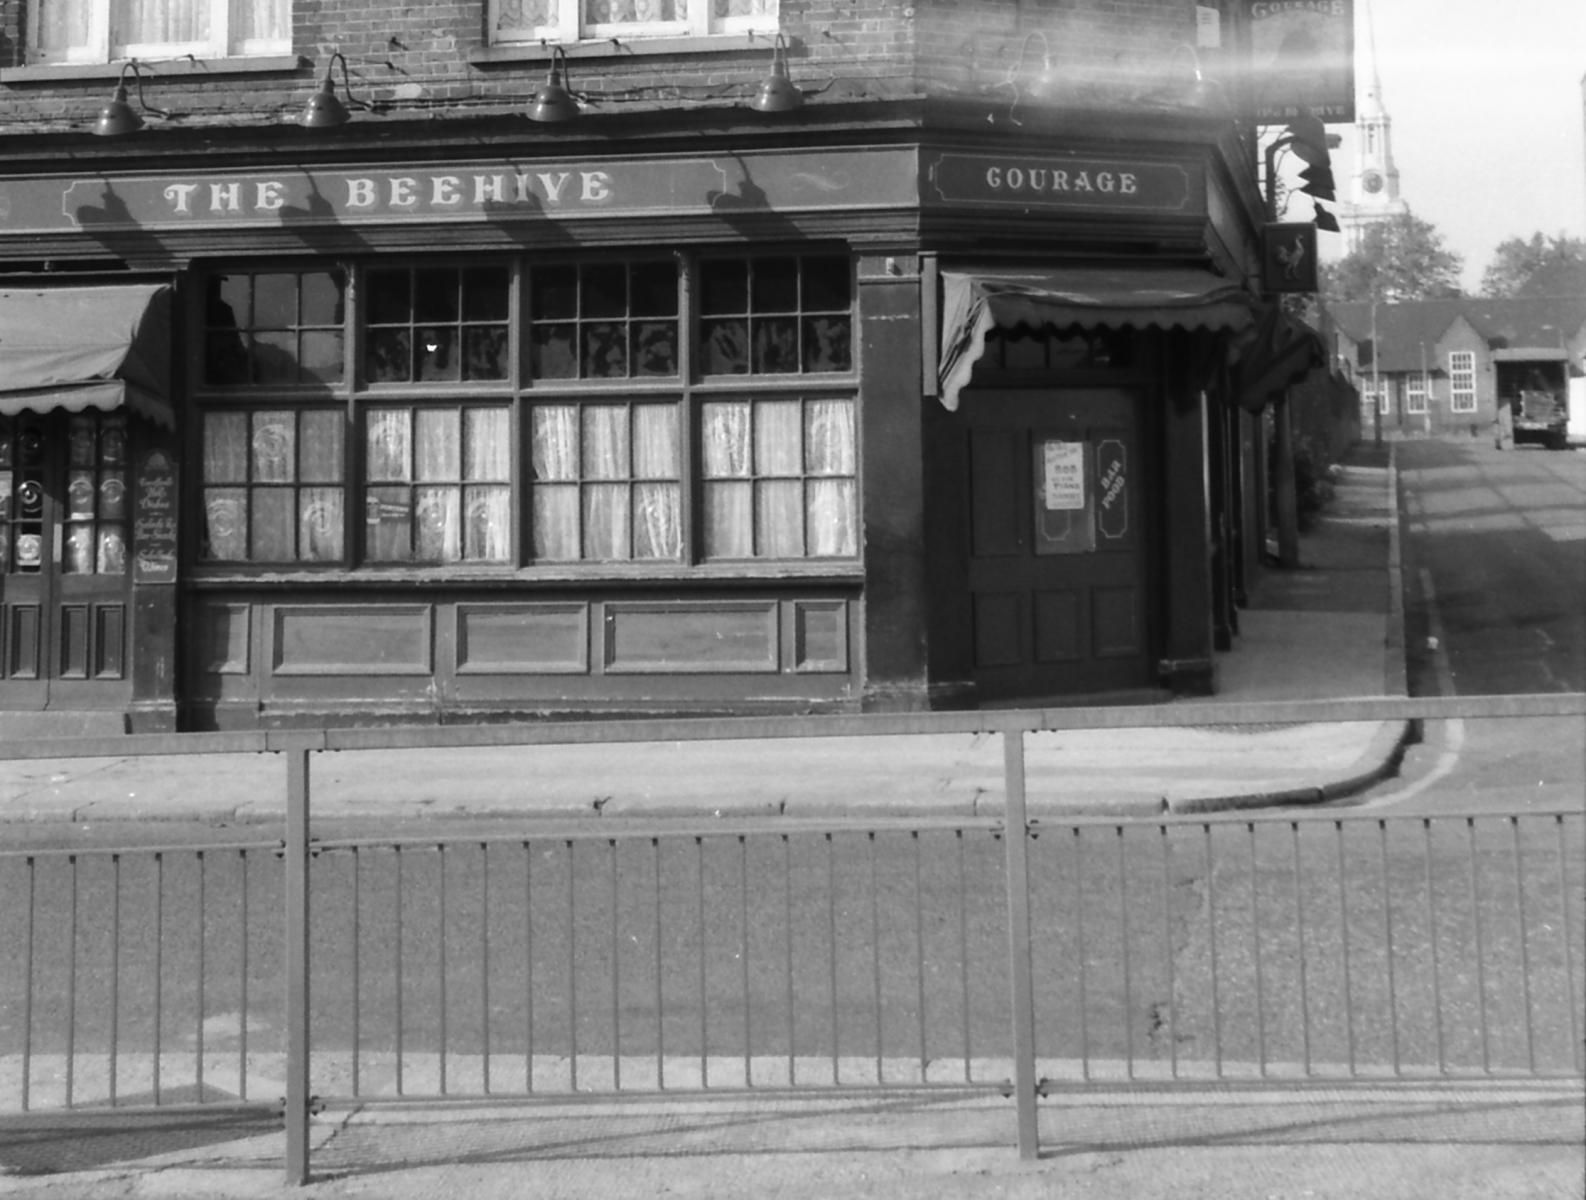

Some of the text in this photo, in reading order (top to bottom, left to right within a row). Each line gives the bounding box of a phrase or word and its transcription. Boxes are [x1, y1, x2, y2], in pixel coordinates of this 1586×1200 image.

[1251, 0, 1346, 18] COURAGE
[163, 170, 613, 214] THE BEEHIVE
[986, 166, 1138, 195] COURAGE
[1101, 460, 1121, 489] BAR
[1102, 476, 1125, 509] FOOD
